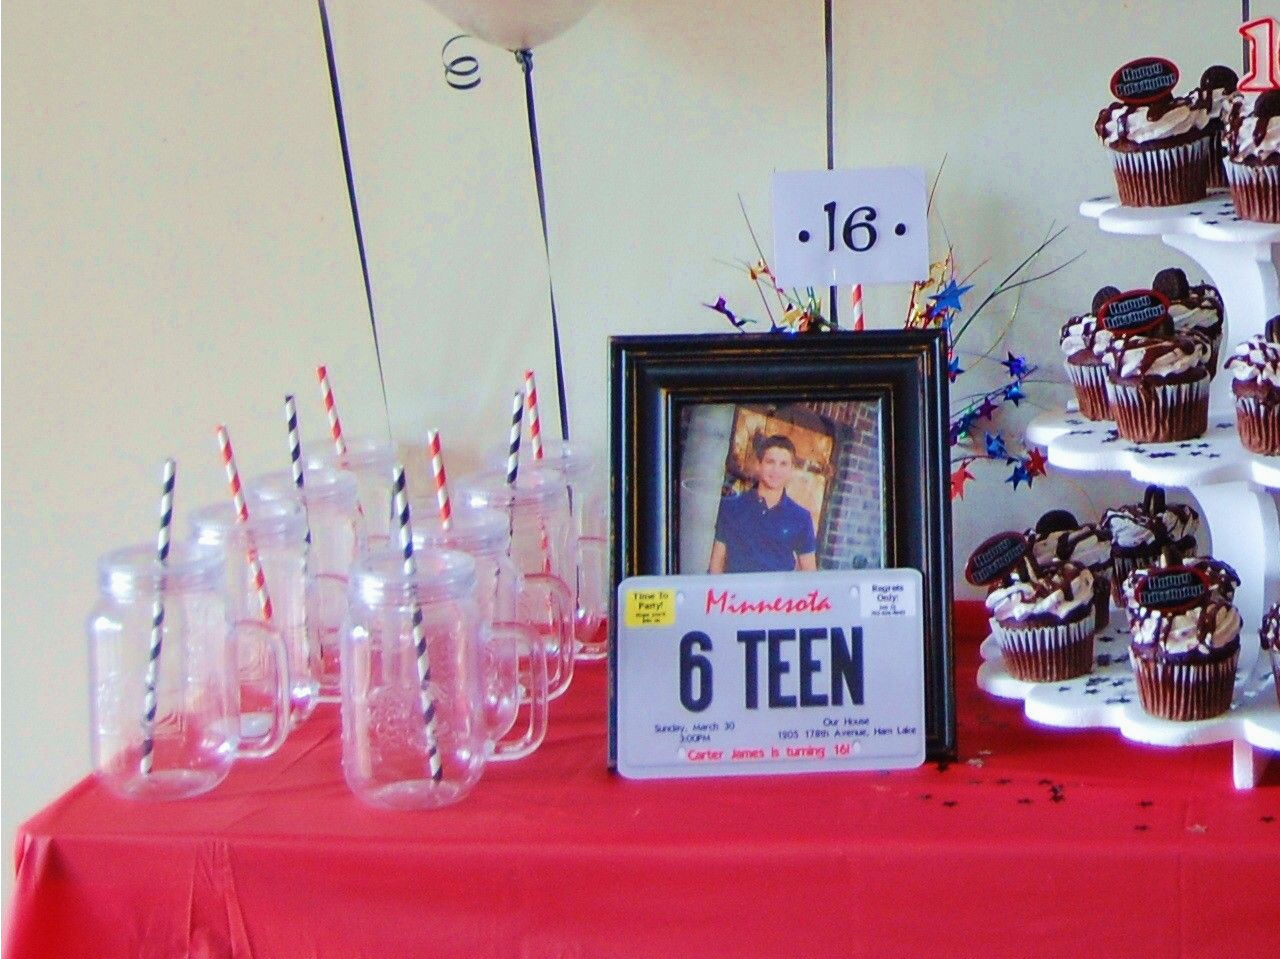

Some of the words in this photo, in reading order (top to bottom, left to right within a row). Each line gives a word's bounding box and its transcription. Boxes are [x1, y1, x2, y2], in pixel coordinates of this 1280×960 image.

[823, 201, 877, 252] 16
[704, 588, 832, 615] Minnesota
[679, 630, 713, 713] 6
[736, 626, 865, 710] TEEN
[844, 717, 870, 726] House
[687, 749, 724, 761] Carter
[731, 748, 765, 760] James
[786, 746, 825, 758] turning
